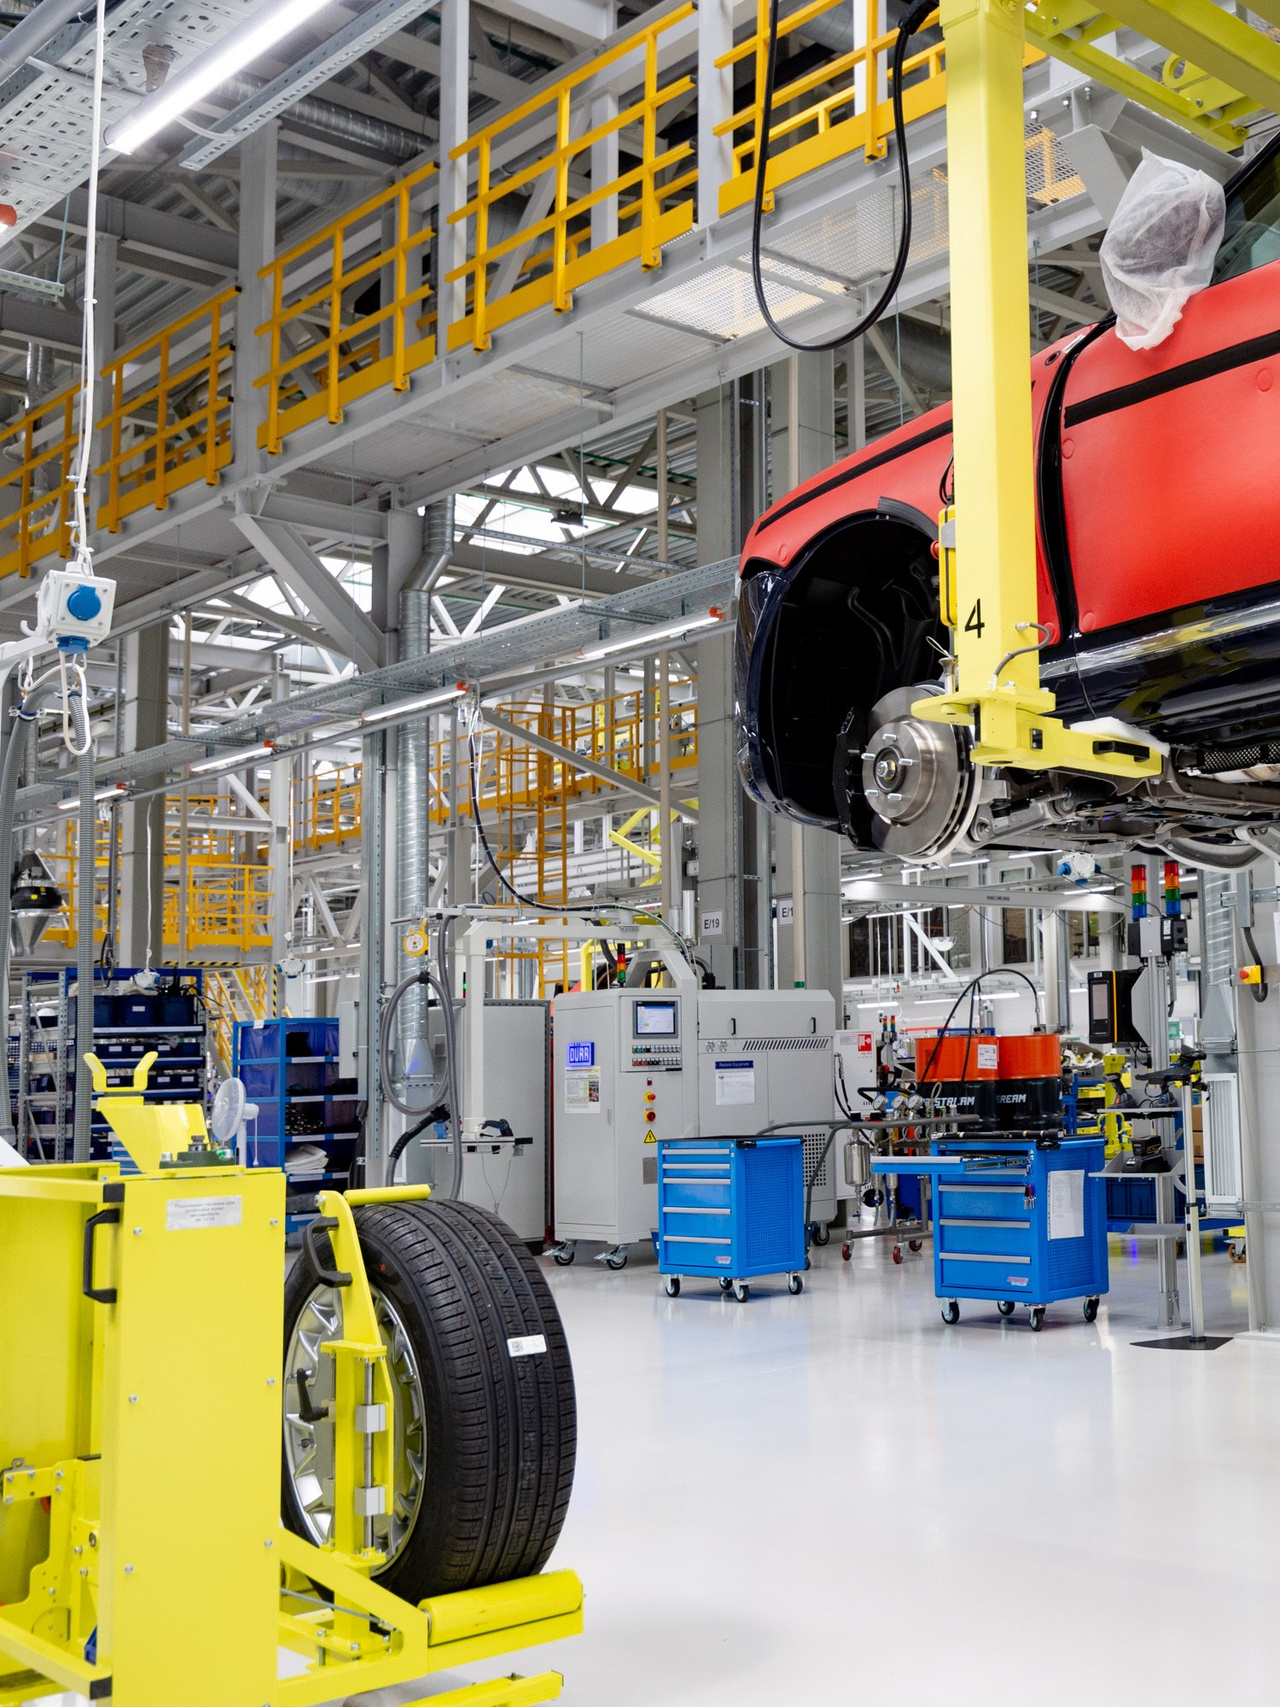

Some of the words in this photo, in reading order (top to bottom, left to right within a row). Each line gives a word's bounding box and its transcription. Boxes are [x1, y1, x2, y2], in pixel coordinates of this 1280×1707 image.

[965, 598, 985, 639] 4
[782, 907, 794, 918] E/1
[704, 918, 720, 930] E/19
